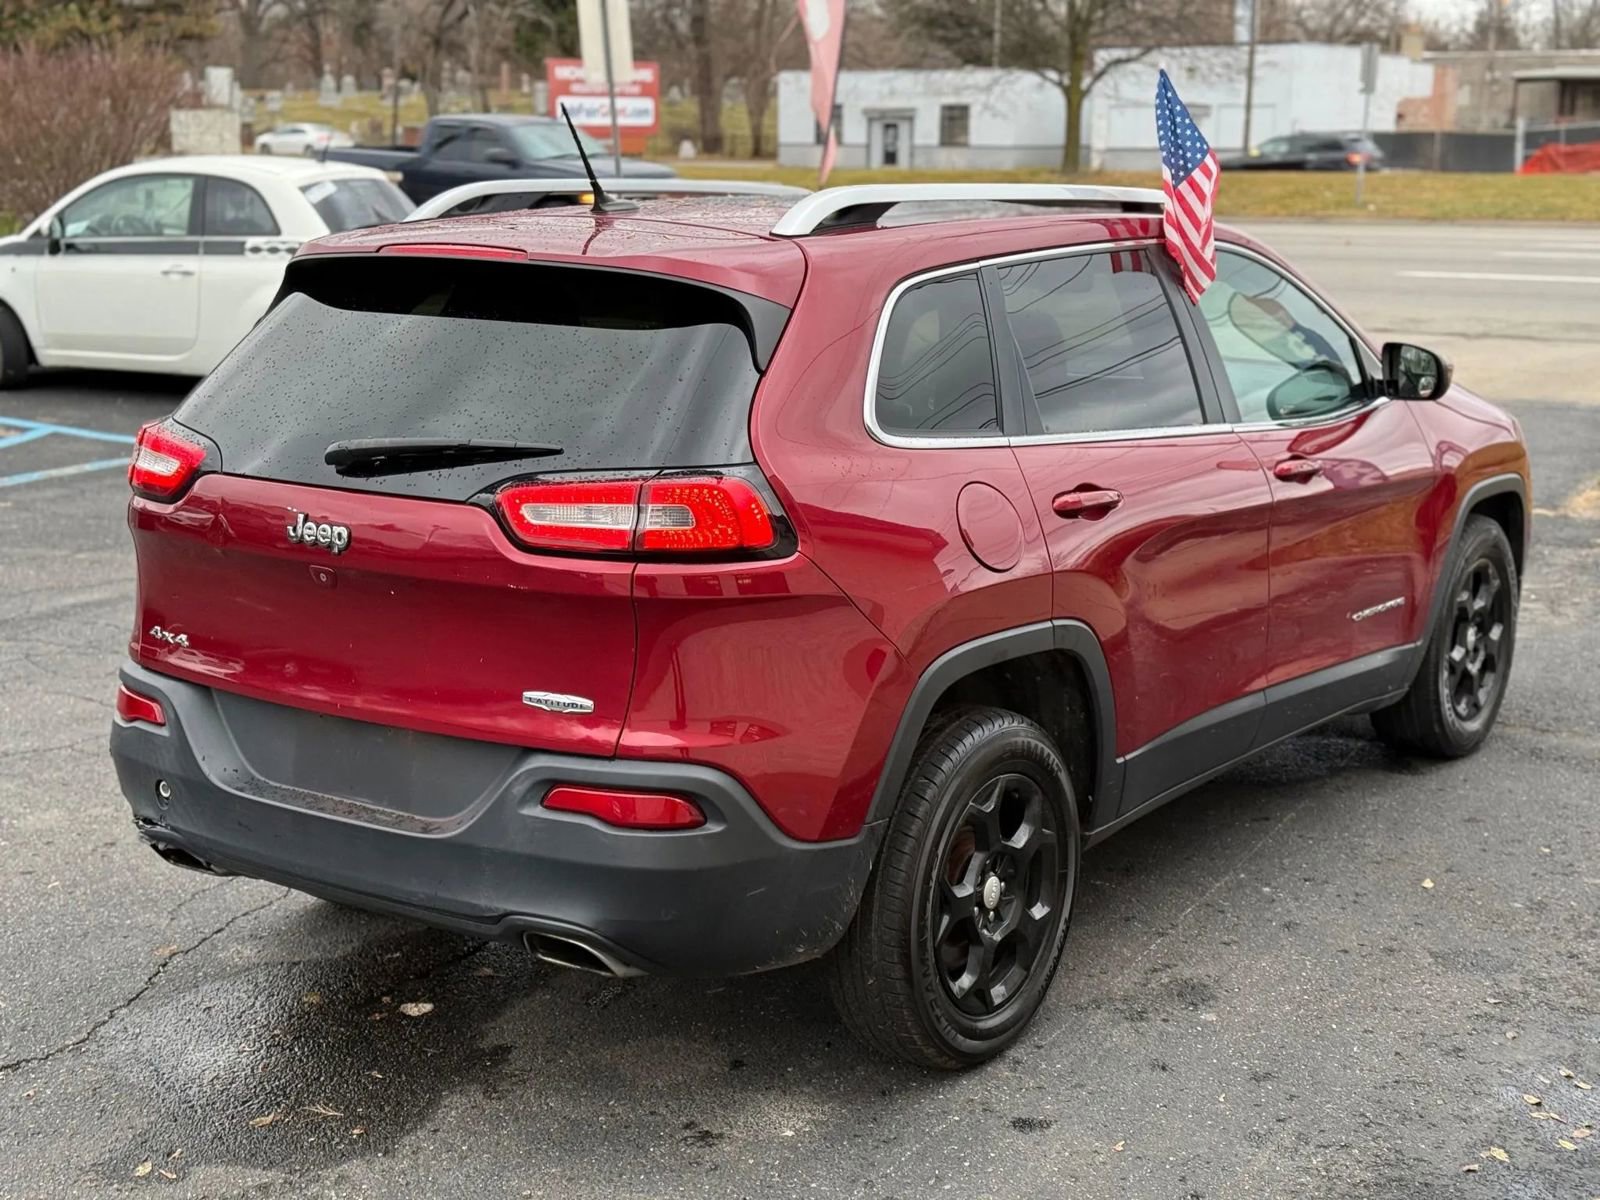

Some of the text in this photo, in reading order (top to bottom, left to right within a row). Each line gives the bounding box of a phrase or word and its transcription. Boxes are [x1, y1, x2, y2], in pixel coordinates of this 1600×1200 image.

[287, 512, 351, 554] Jeep
[149, 625, 190, 648] 4x4
[529, 697, 585, 710] LATITUDE
